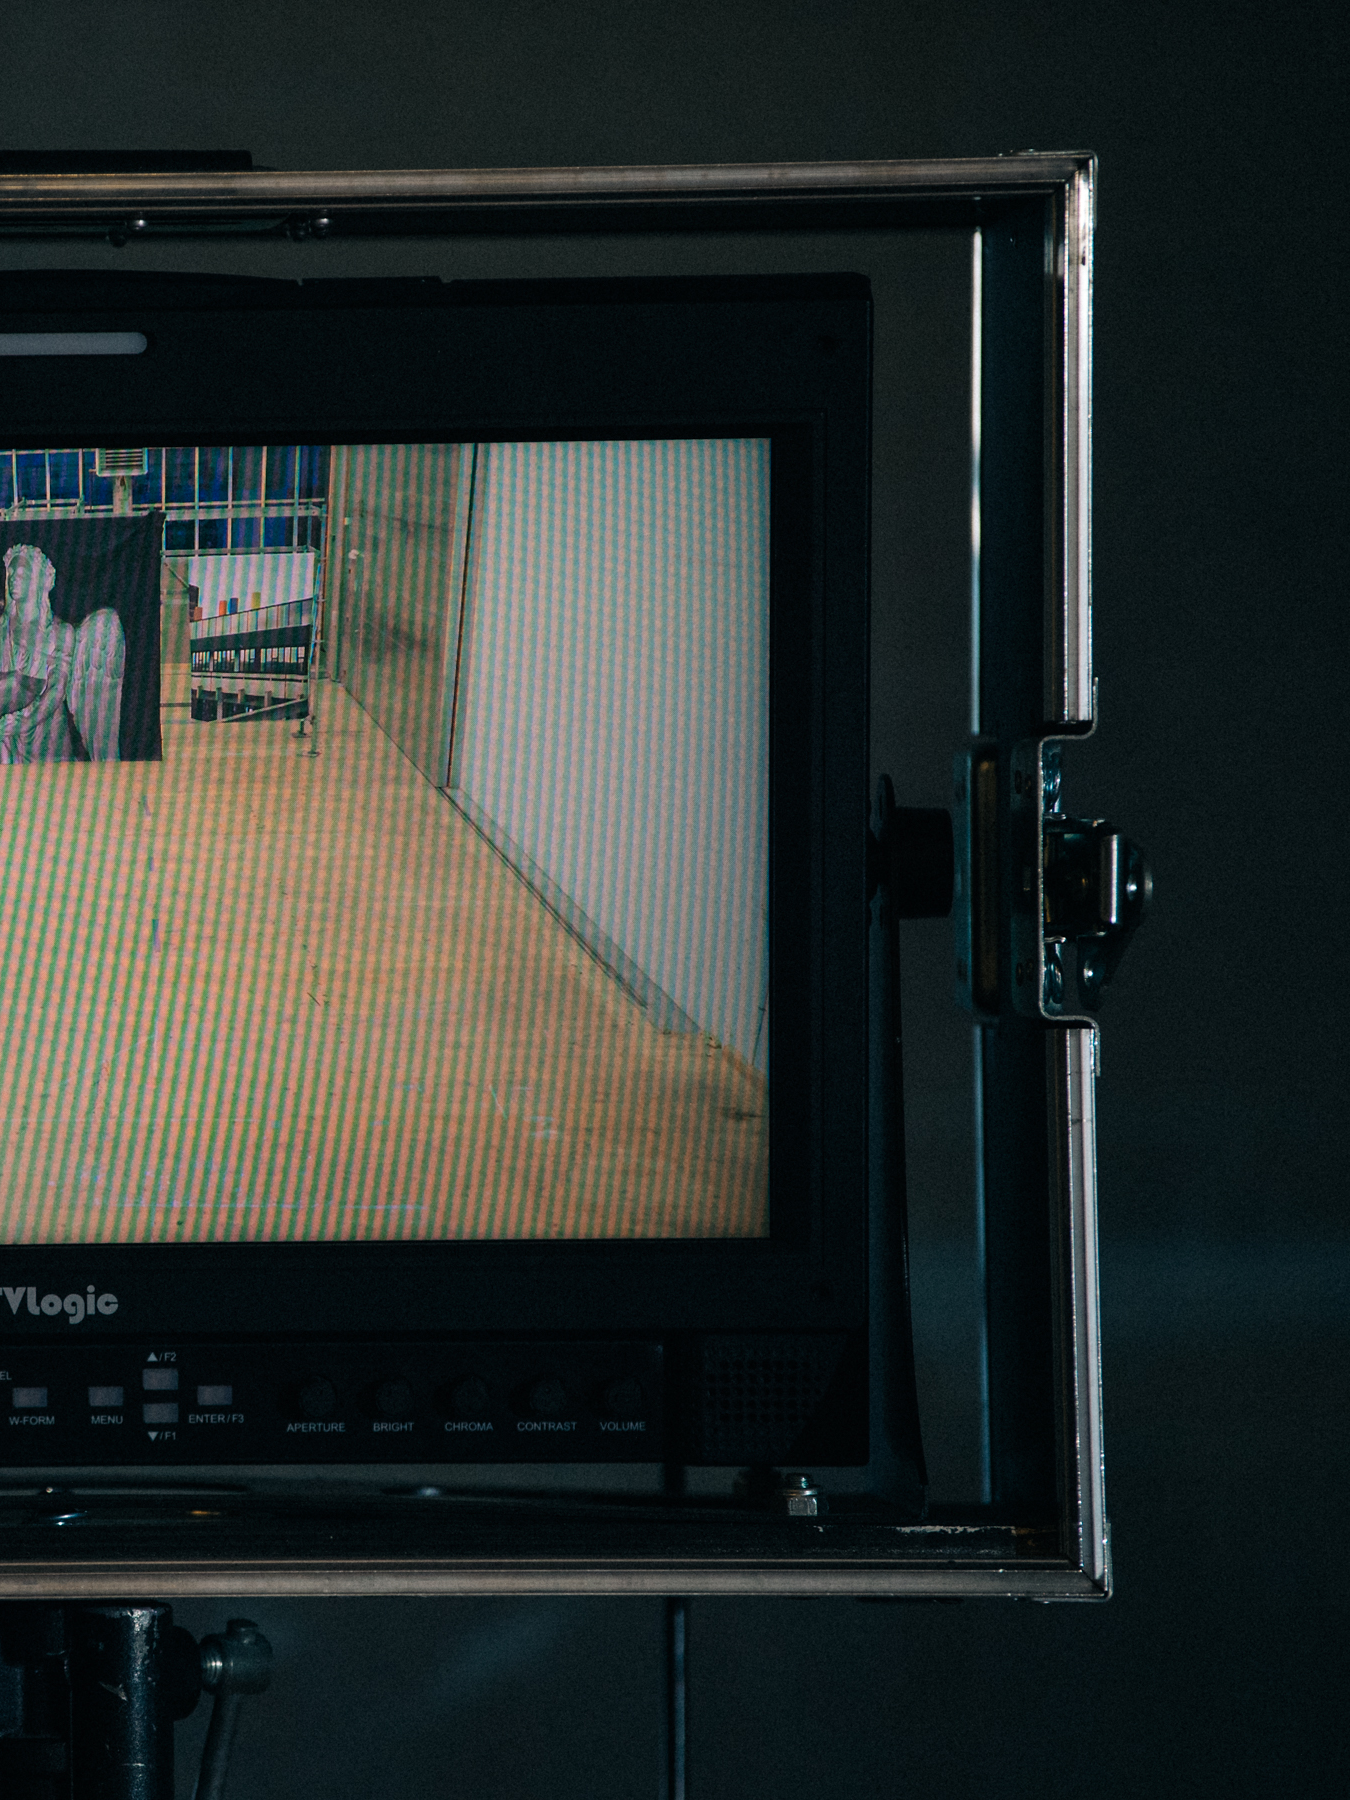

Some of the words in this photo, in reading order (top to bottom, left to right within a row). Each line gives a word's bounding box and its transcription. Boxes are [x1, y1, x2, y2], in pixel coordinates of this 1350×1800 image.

[9, 1416, 55, 1426] W-FORM
[91, 1415, 124, 1426] MENU
[287, 1422, 346, 1433] APERTURE
[373, 1421, 415, 1433] BRIGHT
[444, 1421, 494, 1432] CHROMA
[517, 1421, 578, 1432] CONTRAST
[599, 1421, 647, 1432] VOLUME
